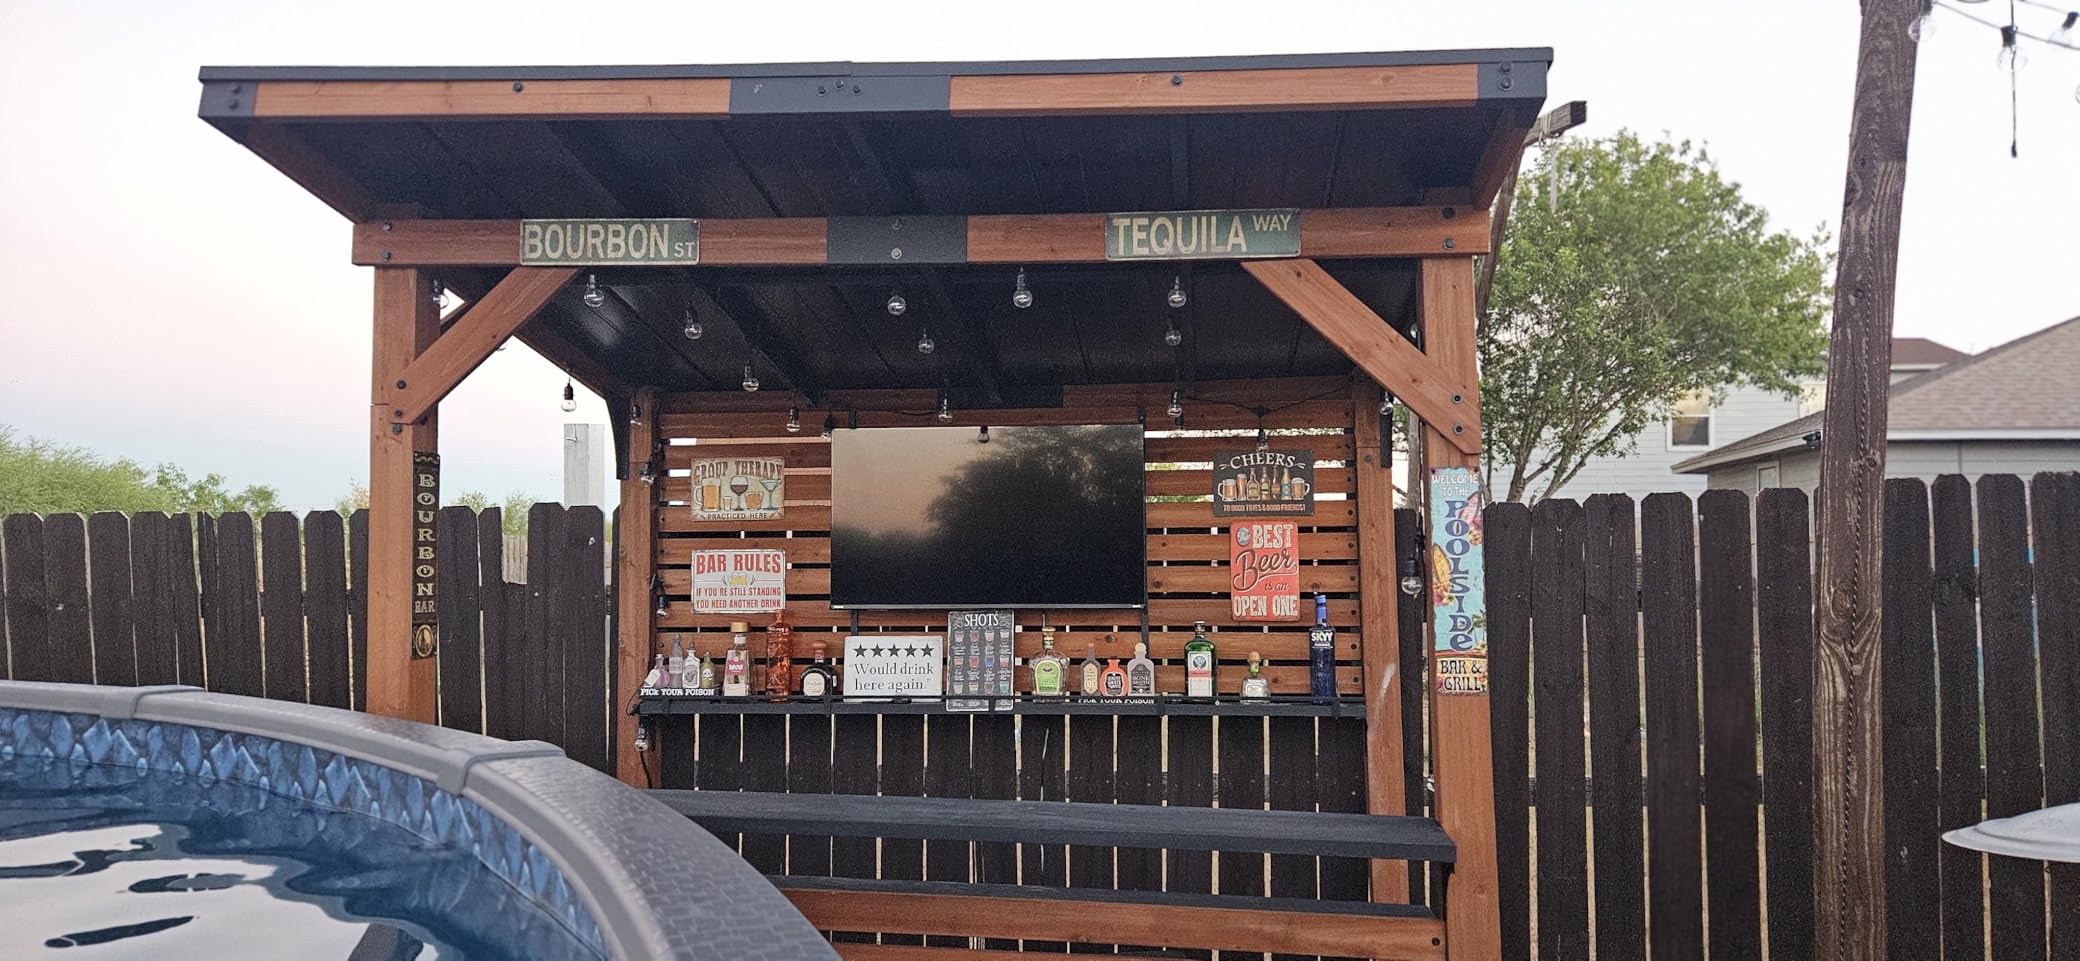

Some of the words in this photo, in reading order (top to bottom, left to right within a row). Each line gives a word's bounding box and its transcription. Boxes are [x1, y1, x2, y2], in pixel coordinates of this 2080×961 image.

[524, 223, 669, 259] BOURBON
[674, 242, 696, 258] ST
[1112, 215, 1248, 256] TEQUILA
[1252, 214, 1292, 232] WAY
[1230, 452, 1296, 469] CHEERS
[694, 461, 729, 485] GROUP
[735, 460, 783, 480] THERAPY
[1431, 474, 1479, 484] WELCOME
[1442, 487, 1452, 497] TO
[1455, 486, 1470, 496] THE
[416, 473, 436, 597] BOURBON
[1252, 524, 1294, 549] BEST
[696, 554, 727, 574] BAR
[734, 553, 781, 574] RULES
[1232, 548, 1298, 592] Beer
[696, 588, 703, 597] IF
[729, 587, 747, 597] STILL
[748, 587, 782, 596] STANDING
[1264, 580, 1274, 592] is
[1275, 582, 1290, 592] an
[414, 600, 435, 613] BAR
[696, 600, 709, 609] YOU
[711, 600, 727, 609] NEED
[729, 600, 759, 608] ANOTHER
[760, 599, 781, 608] DRINK
[1233, 596, 1268, 617] OPEN
[1272, 595, 1299, 616] ONE
[964, 613, 999, 627] SHOTS
[1311, 631, 1333, 642] SKYY
[900, 662, 934, 675] drink
[1440, 659, 1467, 675] BAR
[1471, 660, 1482, 674] &
[855, 678, 885, 691] here
[1444, 676, 1481, 691] GRILL
[661, 688, 683, 696] YOUR
[685, 688, 715, 696] POISON
